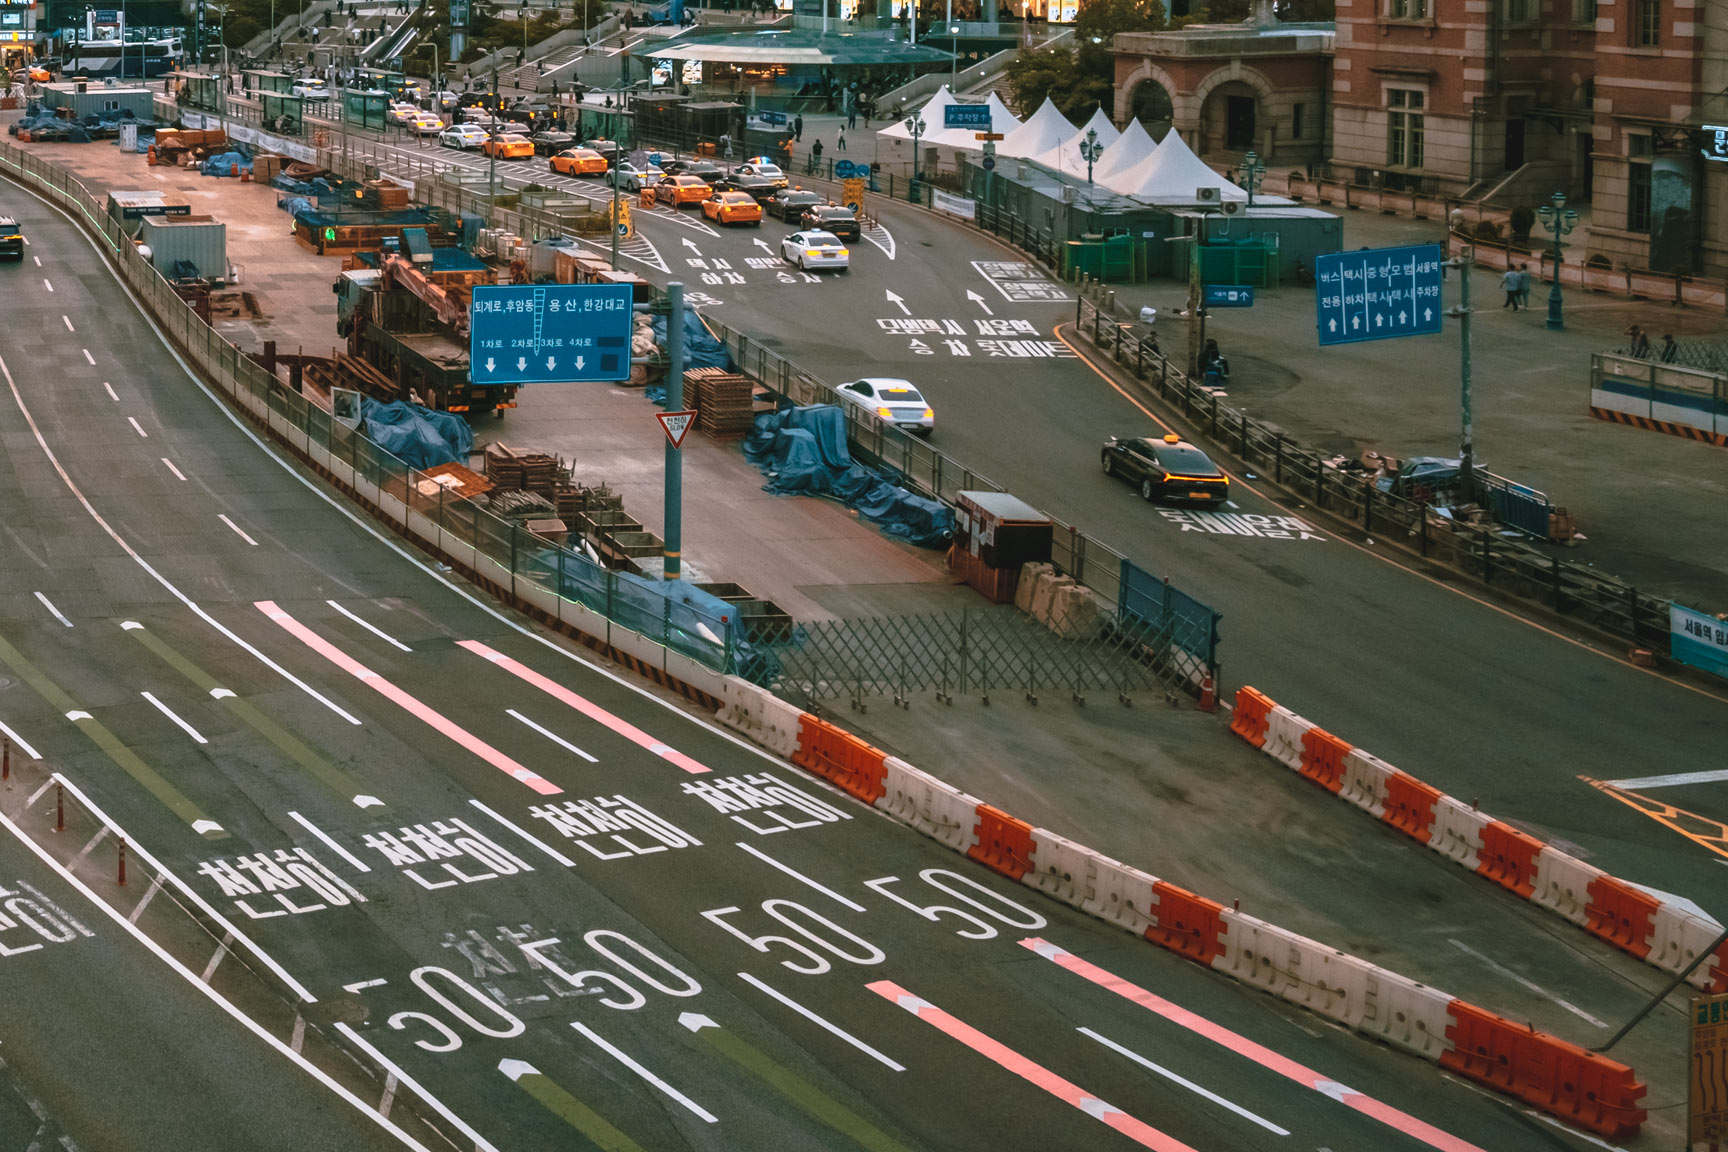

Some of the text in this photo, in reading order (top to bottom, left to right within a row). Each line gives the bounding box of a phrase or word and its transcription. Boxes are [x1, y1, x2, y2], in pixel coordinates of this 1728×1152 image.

[957, 113, 979, 123] 주차장
[685, 258, 733, 270] 택시
[699, 271, 747, 285] 하차
[1320, 260, 1438, 284] 버스 택시 중형 모범 서울역
[1322, 285, 1439, 309] 전용 하차 택시 택시 주차장
[973, 319, 1041, 337] 서울역
[480, 337, 593, 349] 1차로 2차로 3차로 4차로
[975, 339, 1079, 358] 롯데마트
[1154, 507, 1328, 542] 롯데아울렛
[1684, 618, 1712, 641] 서울역
[680, 772, 854, 836] 천천히
[529, 795, 704, 861] 천천히
[365, 817, 535, 890] 천천히
[198, 848, 369, 919] 천천히
[863, 868, 1038, 940] 50
[700, 899, 886, 975] 50
[520, 929, 702, 1011] 50
[342, 966, 526, 1053] 50
